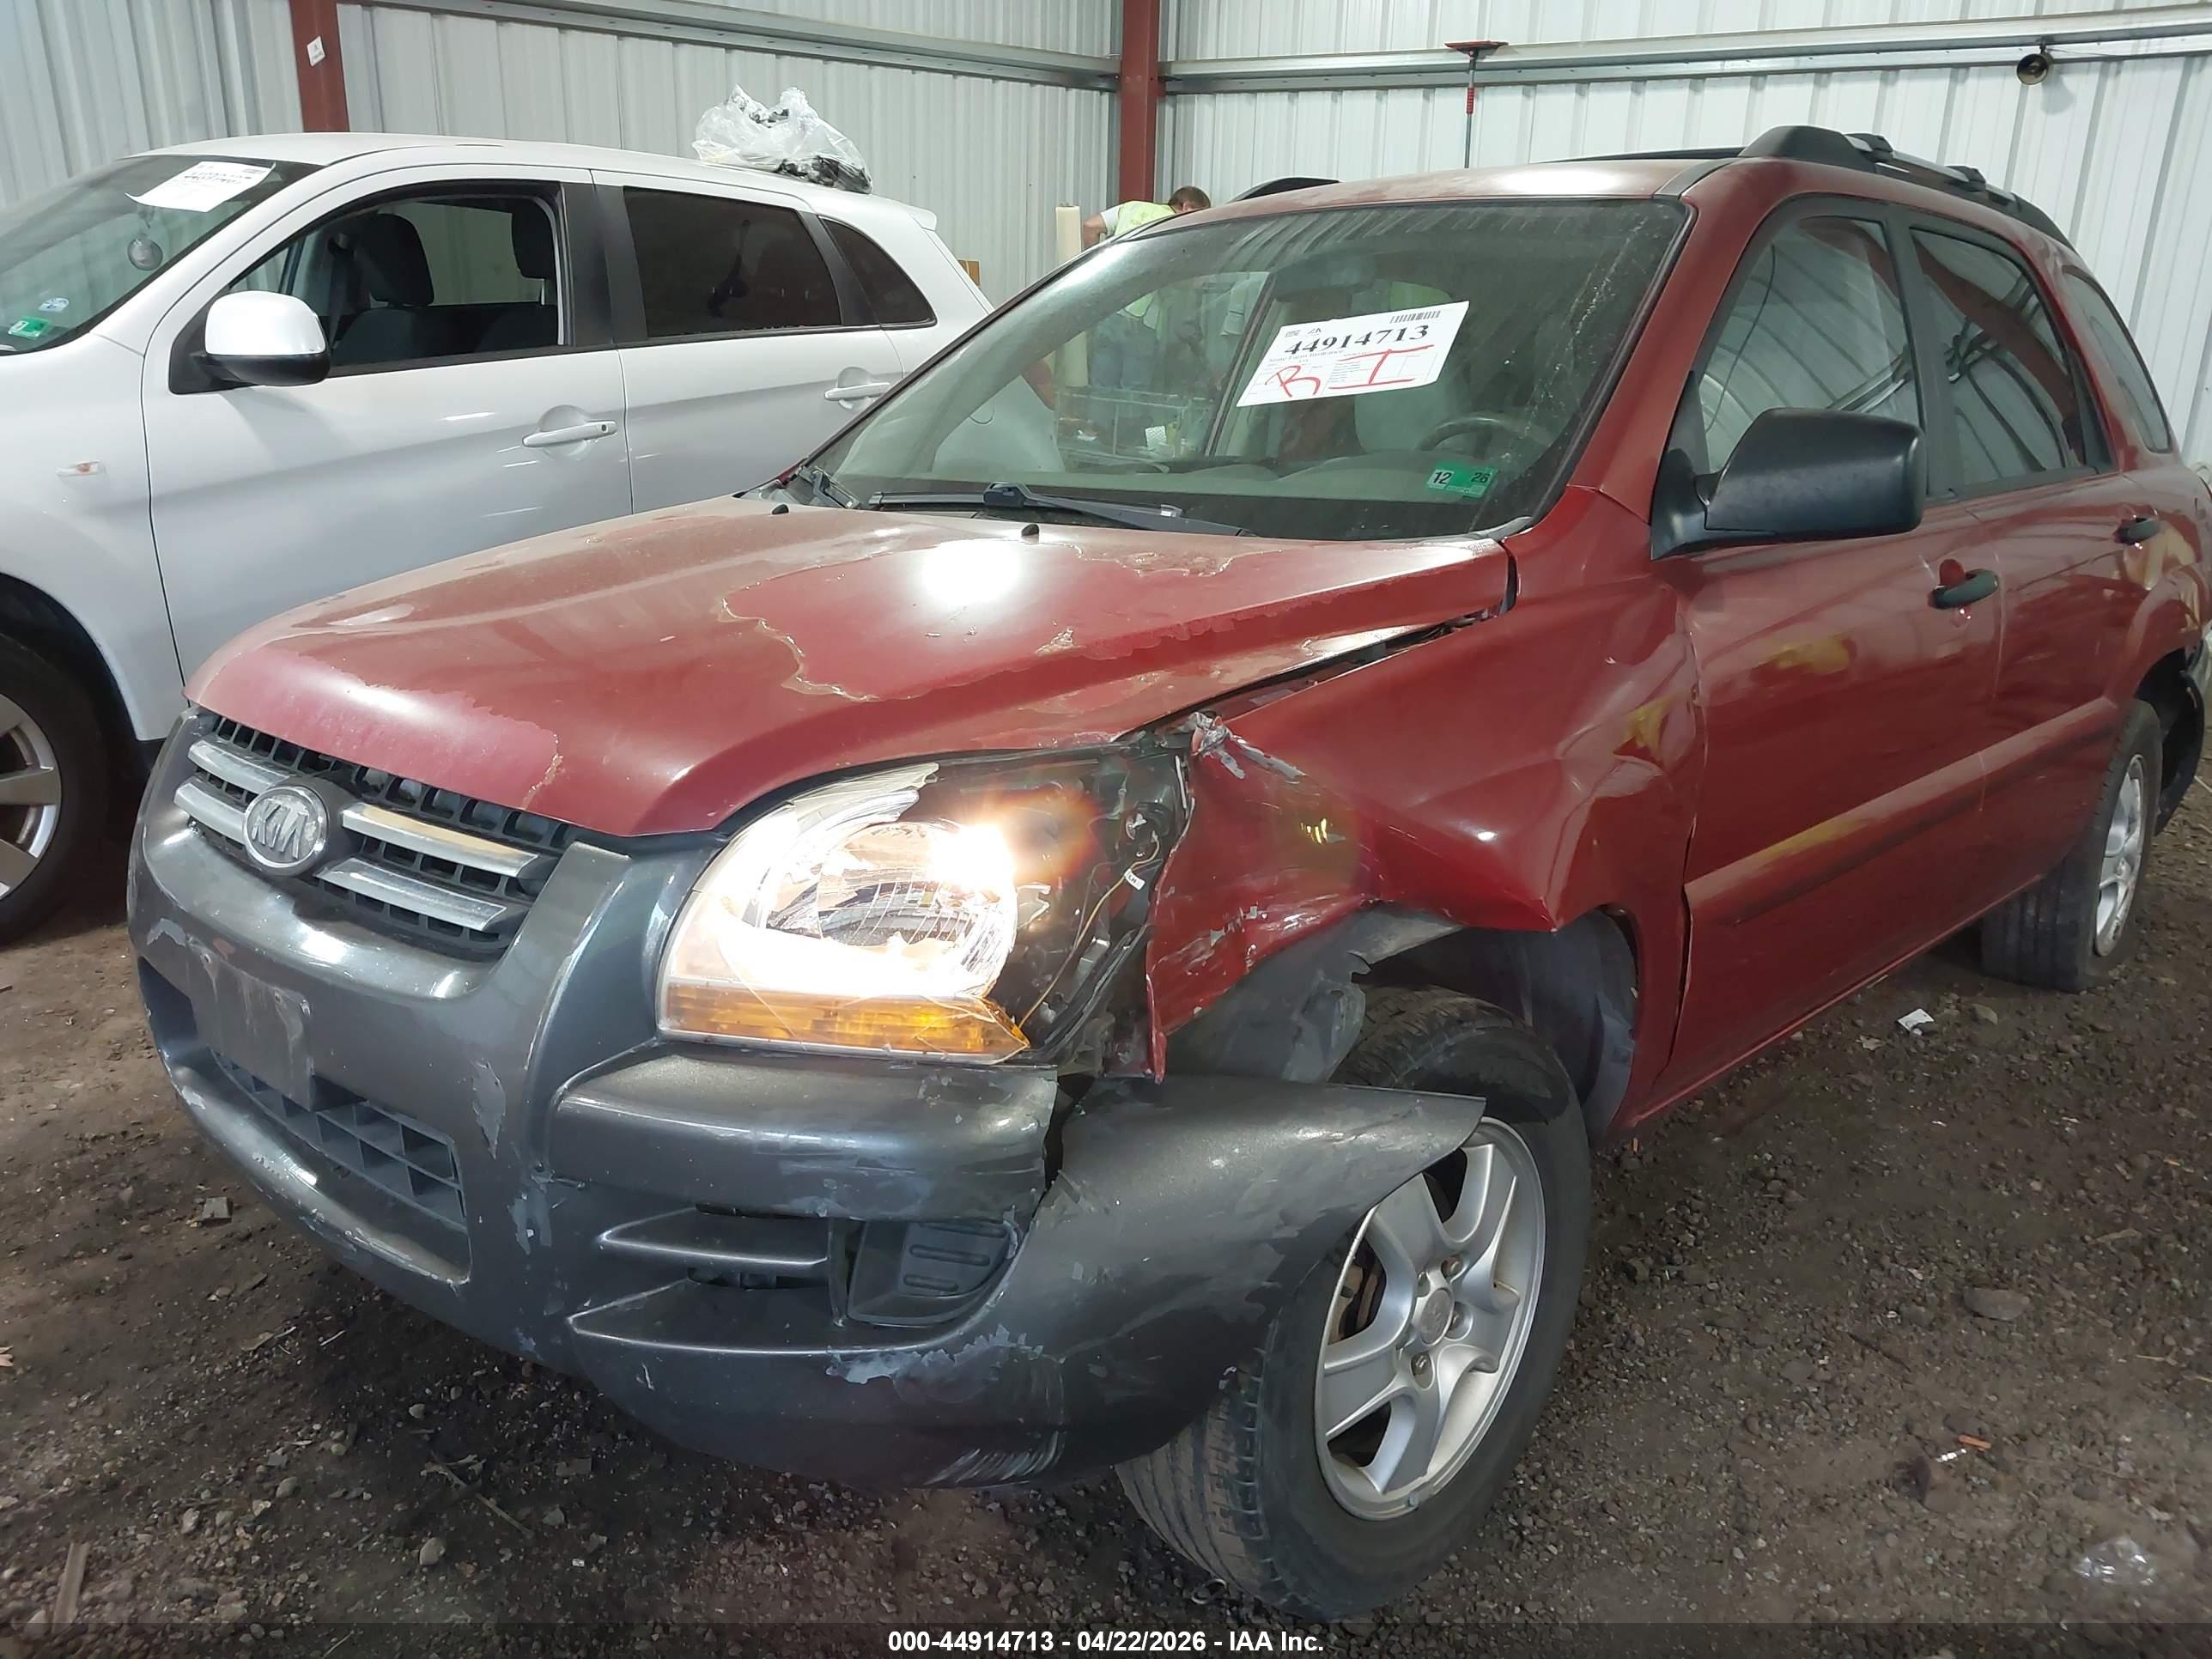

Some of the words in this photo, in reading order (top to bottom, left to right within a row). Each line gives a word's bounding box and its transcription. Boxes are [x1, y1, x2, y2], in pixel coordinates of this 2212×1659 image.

[1285, 325, 1430, 355] 44914713
[1432, 471, 1452, 484] 12
[1471, 472, 1491, 483] 26
